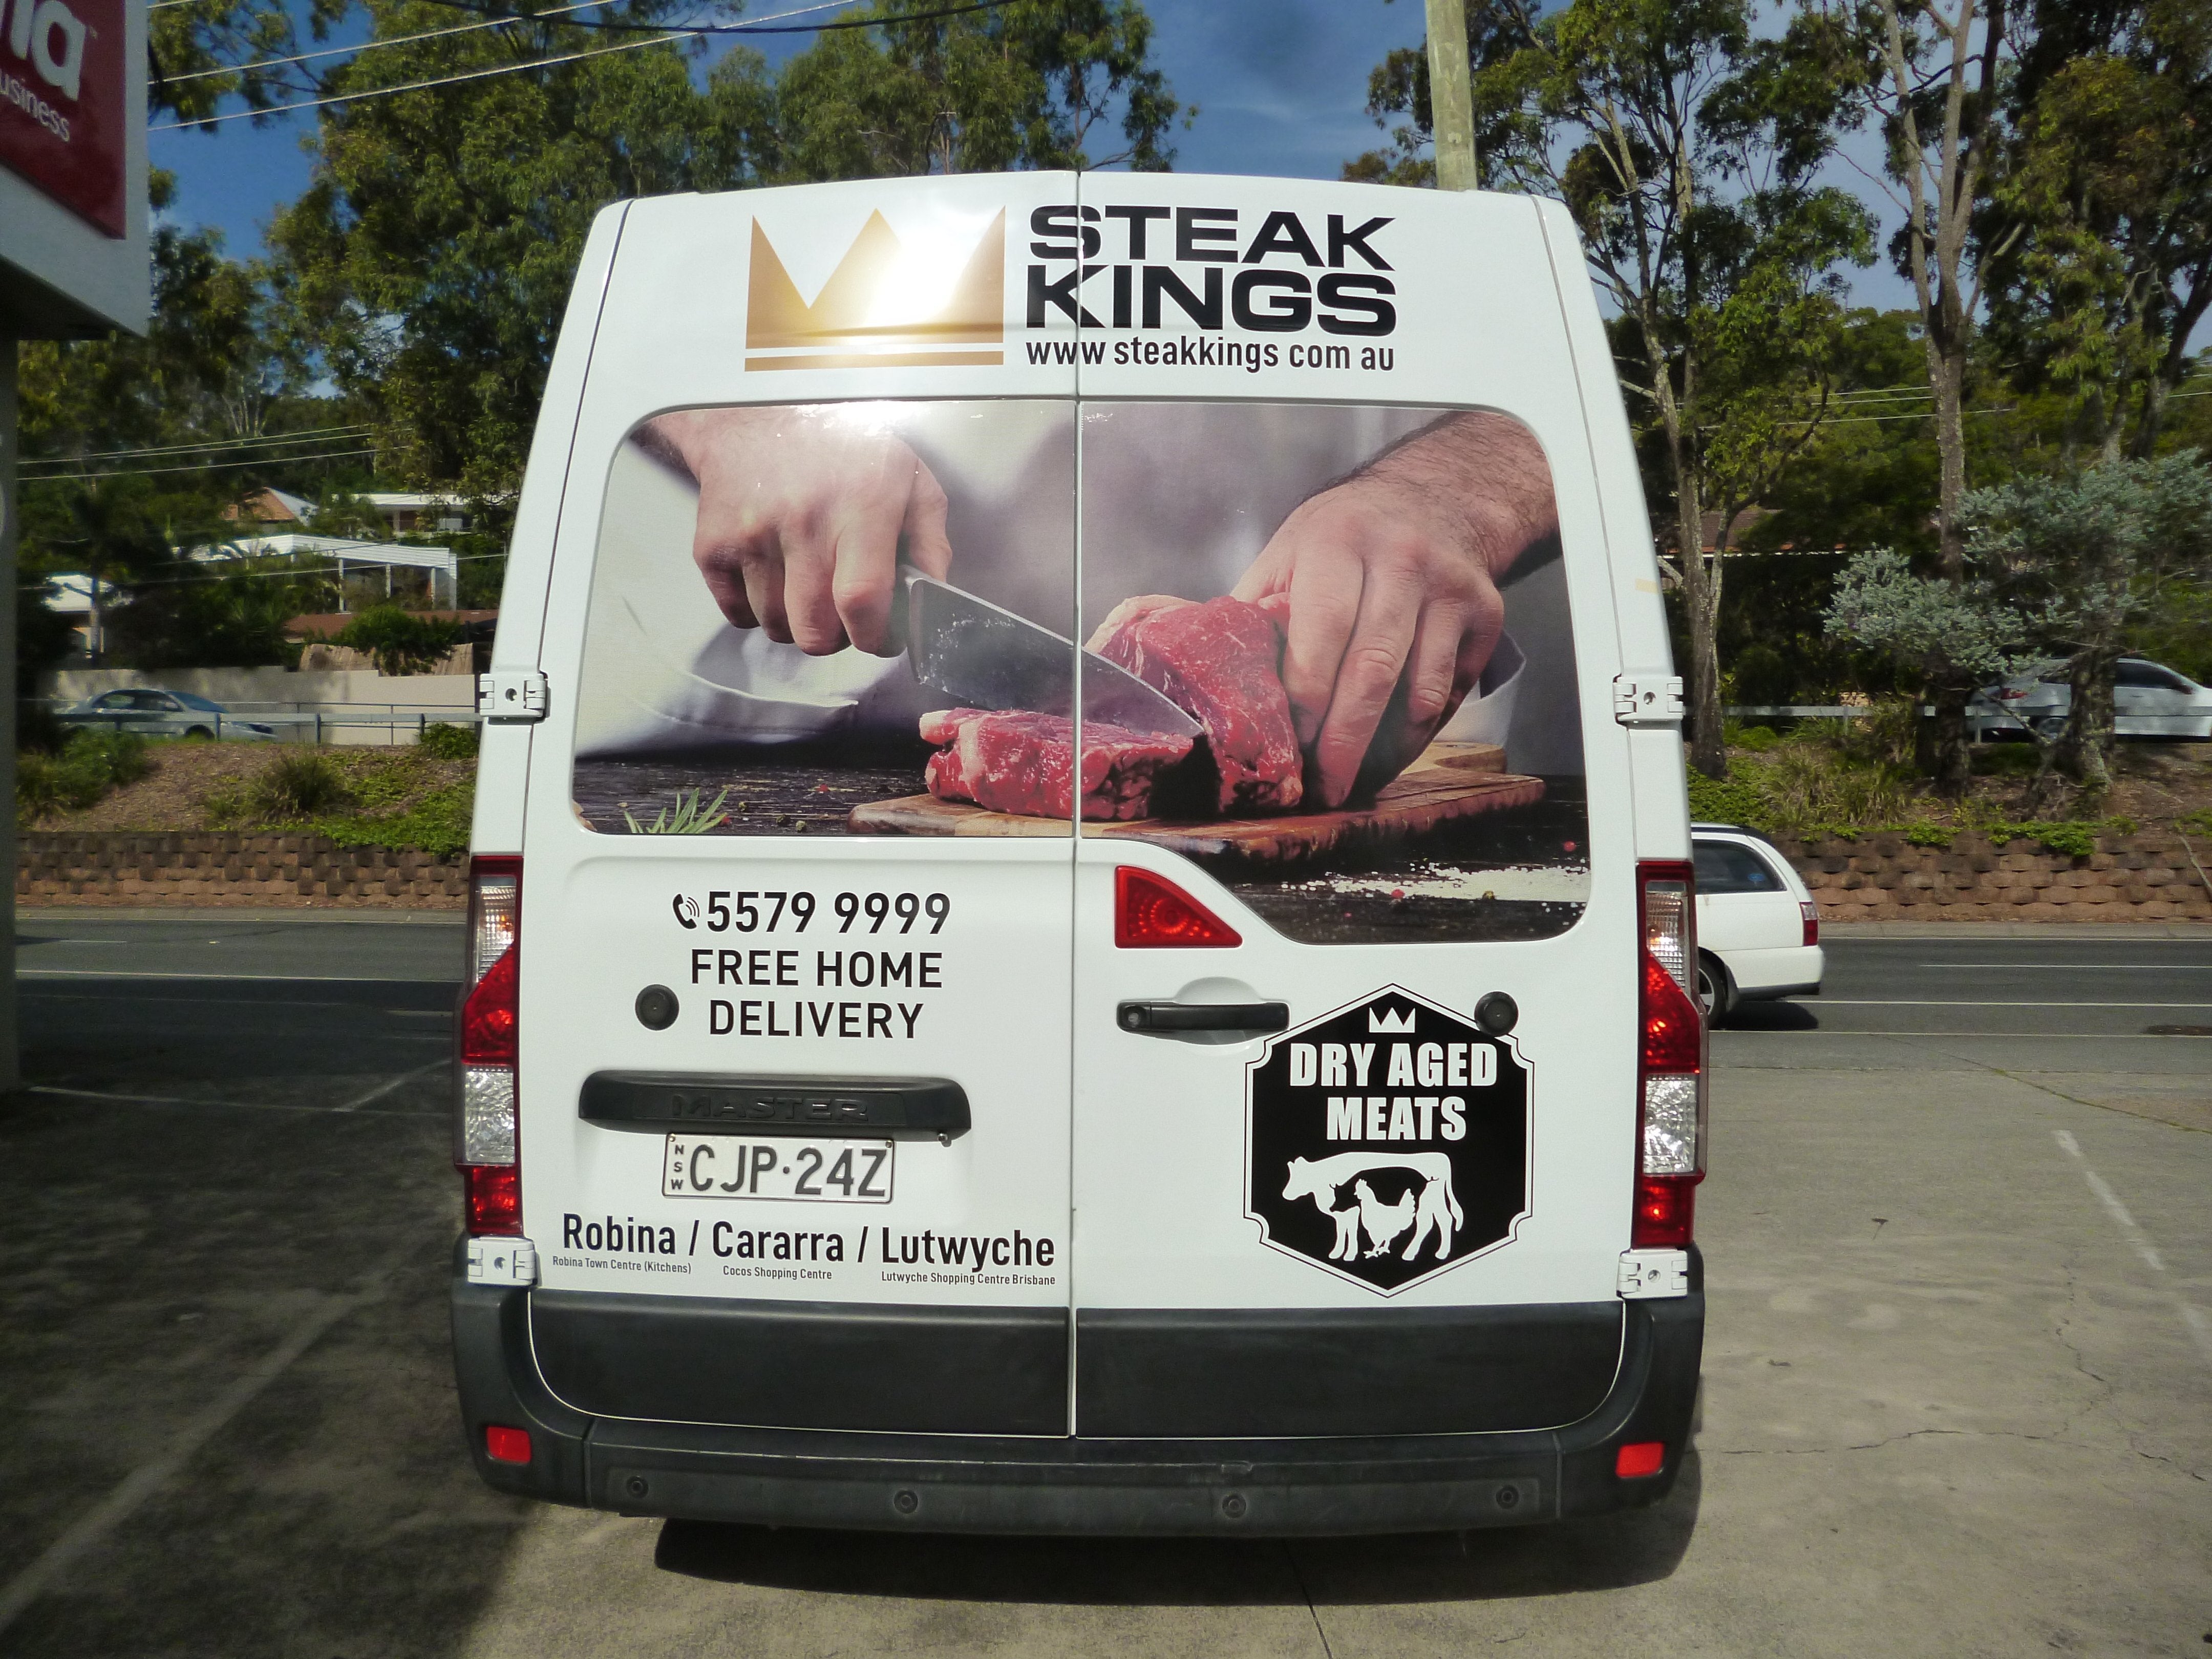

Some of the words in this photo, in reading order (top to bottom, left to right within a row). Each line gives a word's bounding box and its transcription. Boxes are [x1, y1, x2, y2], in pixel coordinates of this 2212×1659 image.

[1029, 204, 1396, 271] STEAK
[1026, 264, 1397, 337] KINGS
[1025, 341, 1107, 366] www
[1114, 335, 1279, 373] steakkings
[1289, 344, 1350, 369] com
[1361, 347, 1394, 371] au
[707, 891, 816, 933] 5579
[834, 892, 950, 934] 9999
[692, 949, 799, 986] FREE
[817, 951, 942, 988] HOME
[710, 999, 924, 1039] DELIVERY
[1290, 1043, 1376, 1087] DRY
[1387, 1042, 1497, 1087] AGED
[671, 1094, 868, 1121] MASTER
[1327, 1096, 1466, 1141] MEATS
[564, 1213, 675, 1254] Robina
[713, 1221, 843, 1262] Cararra
[882, 1227, 1054, 1273] Lutwyche
[552, 1256, 583, 1267] Robina
[584, 1258, 608, 1269] Town
[610, 1259, 642, 1271] Centre
[644, 1261, 691, 1274] (Kitchens)
[723, 1265, 752, 1277] Cocos
[754, 1266, 797, 1281] Shopping
[800, 1268, 832, 1280] Centre
[882, 1271, 928, 1284] Lutwyche
[930, 1272, 975, 1285] Shopping
[977, 1273, 1010, 1285] Centre
[1012, 1274, 1055, 1286] Brisbane
